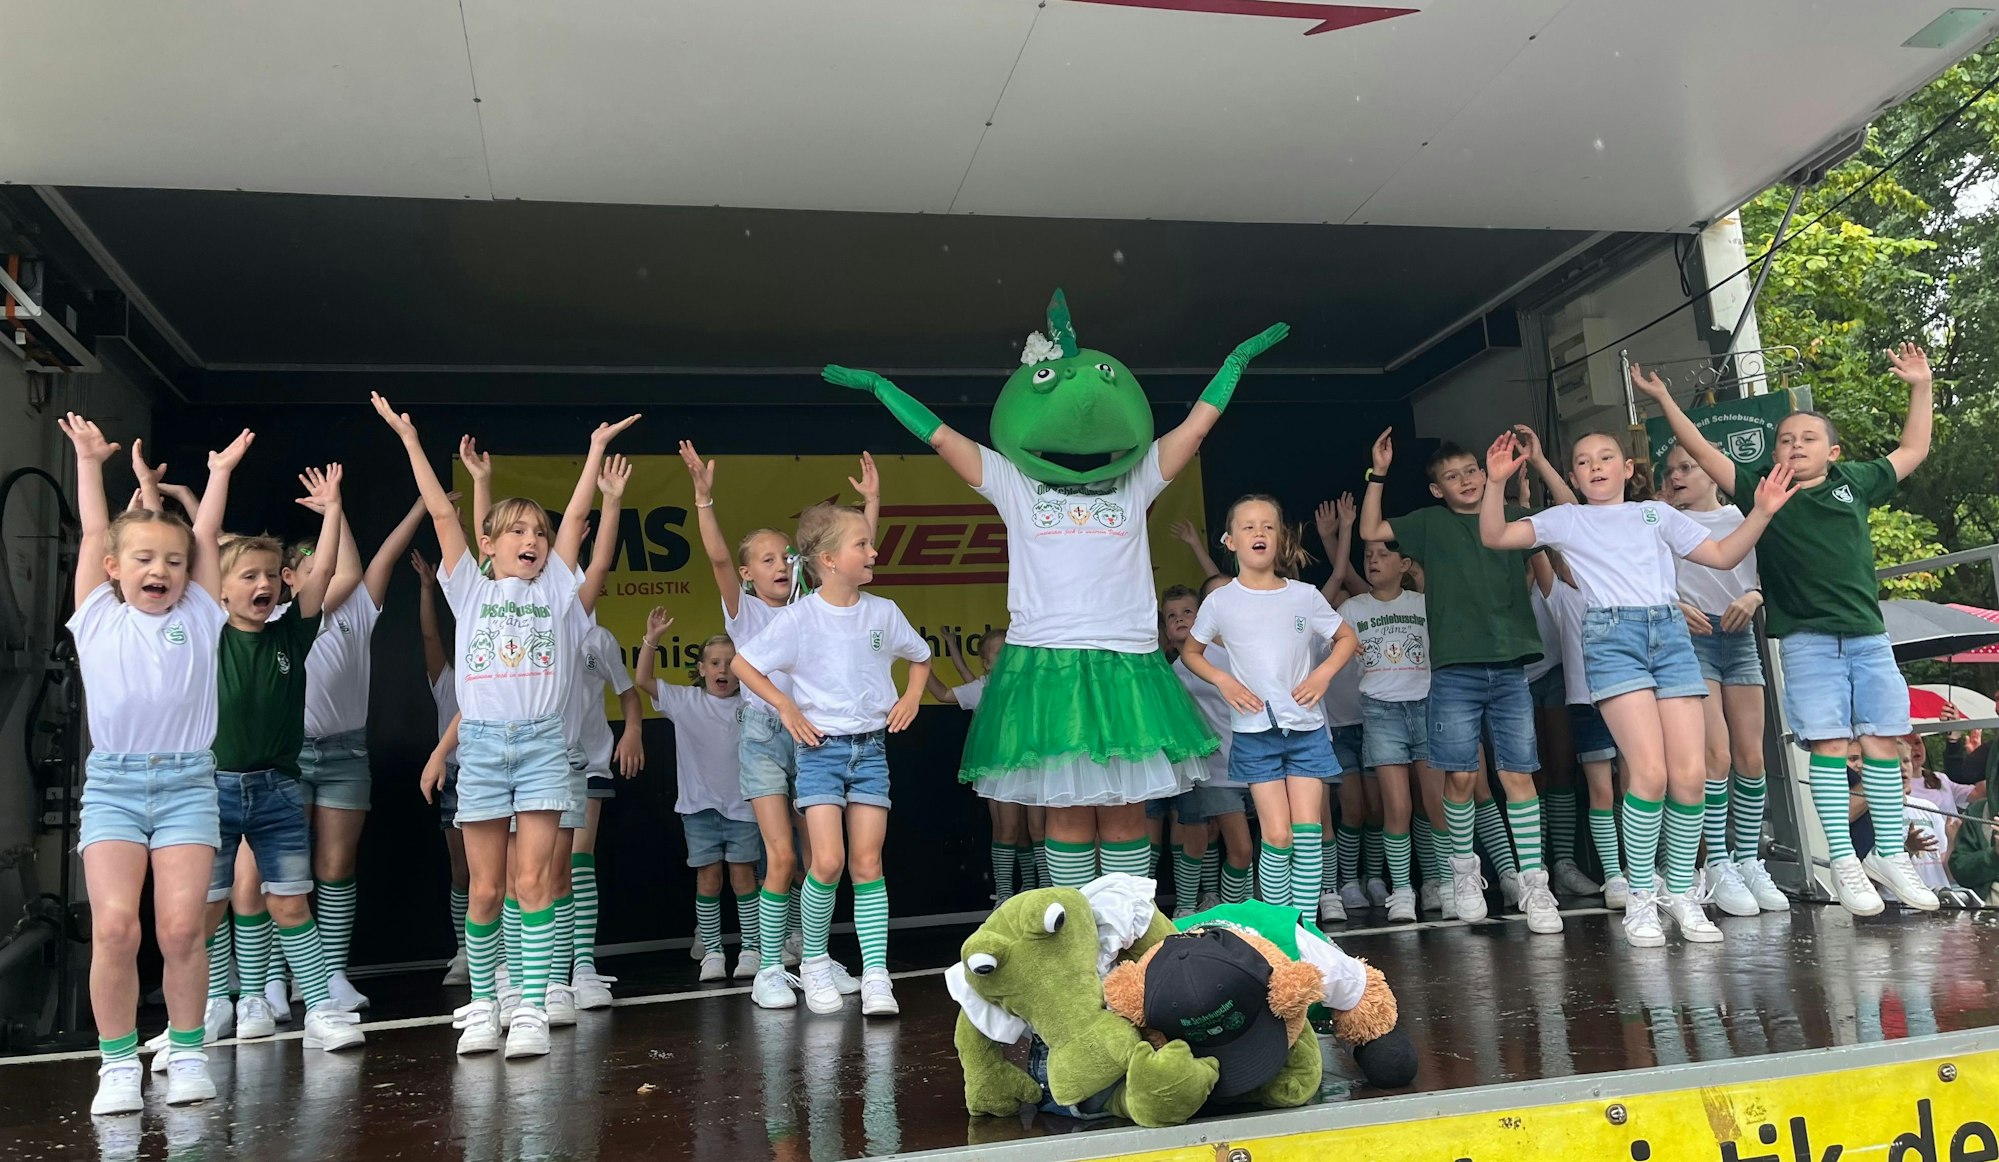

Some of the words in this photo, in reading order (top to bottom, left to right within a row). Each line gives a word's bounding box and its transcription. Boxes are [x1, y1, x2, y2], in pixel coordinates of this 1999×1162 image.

[1656, 444, 1668, 457] KG
[1712, 414, 1765, 425] Schlebusch
[544, 505, 690, 572] MS
[617, 582, 690, 596] LOGISTIK
[1357, 620, 1369, 633] Die
[1370, 613, 1426, 628] Schlebuscher
